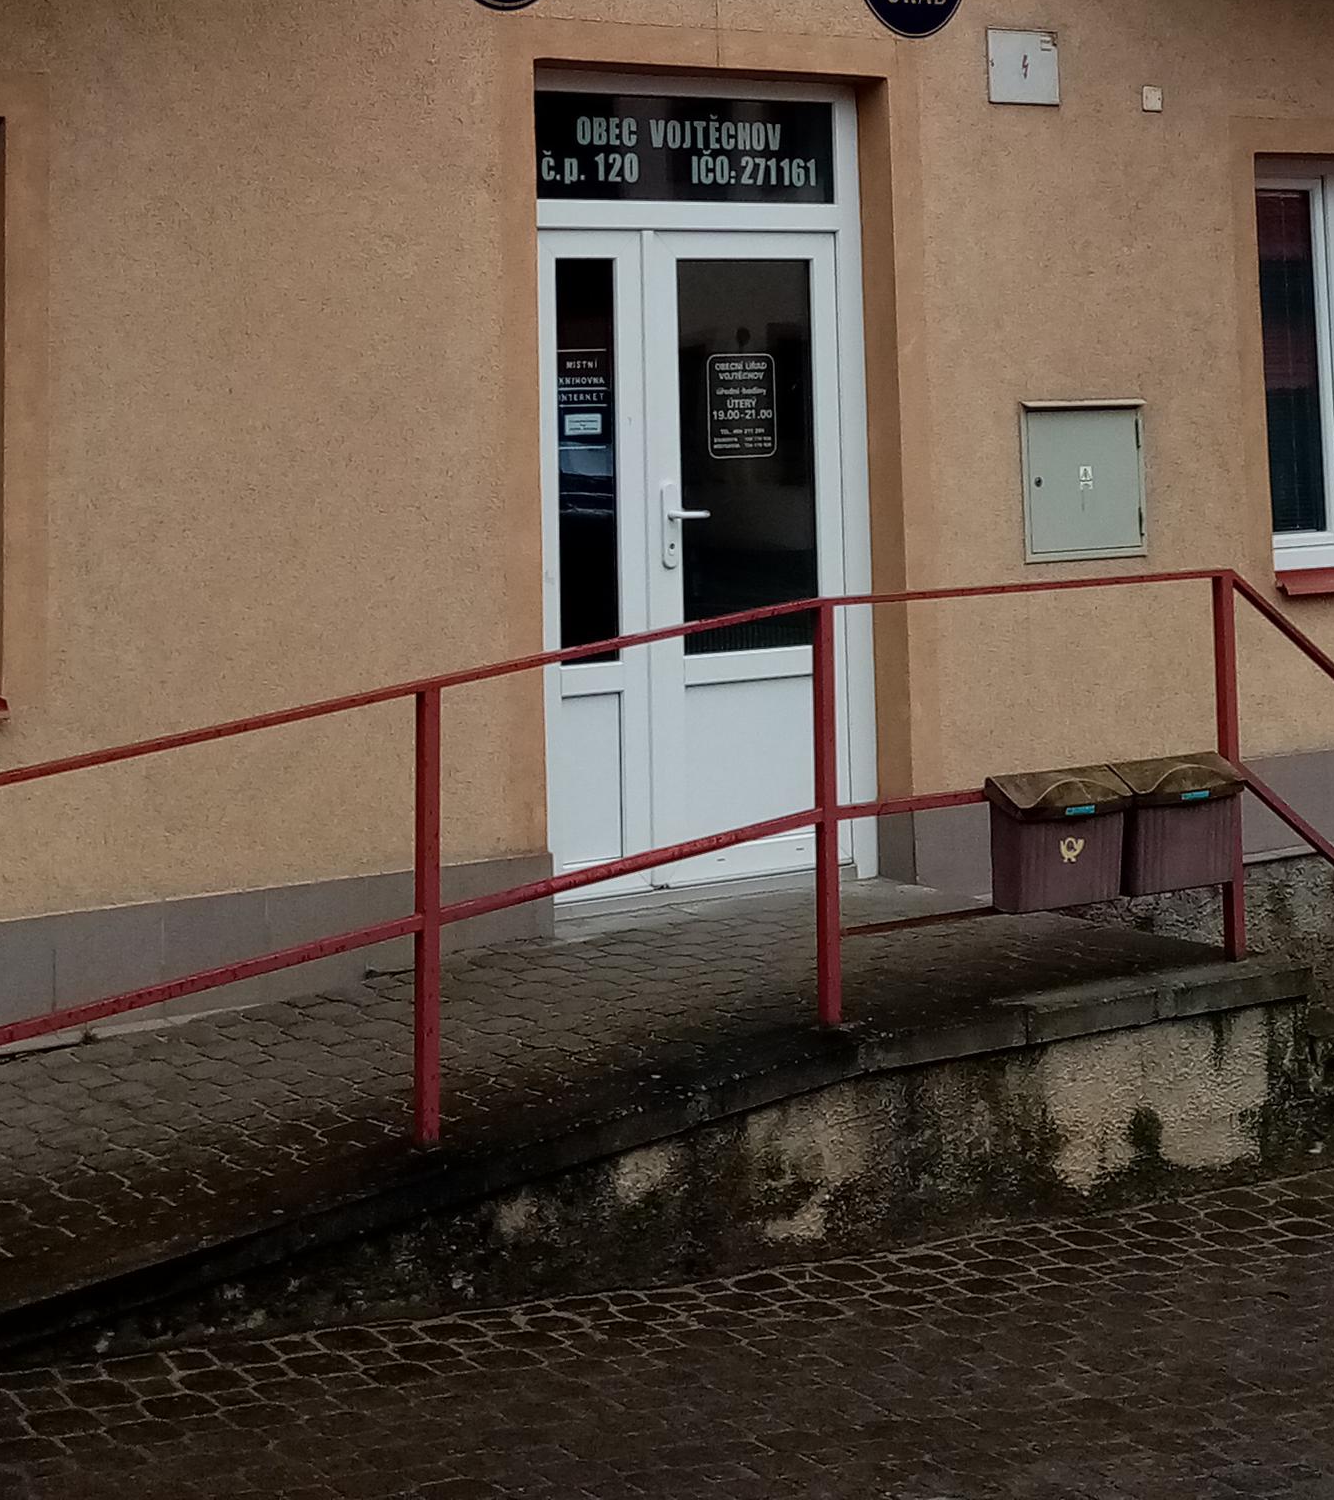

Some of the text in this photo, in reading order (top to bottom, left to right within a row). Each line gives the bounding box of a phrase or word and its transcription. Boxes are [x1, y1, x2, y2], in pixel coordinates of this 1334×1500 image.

[576, 114, 781, 151] OBEC VOJTĚCHOV
[595, 152, 639, 183] 120
[740, 156, 817, 187] 271161
[558, 376, 606, 386] KNIHOVNA
[727, 396, 757, 409] ÚTERÝ
